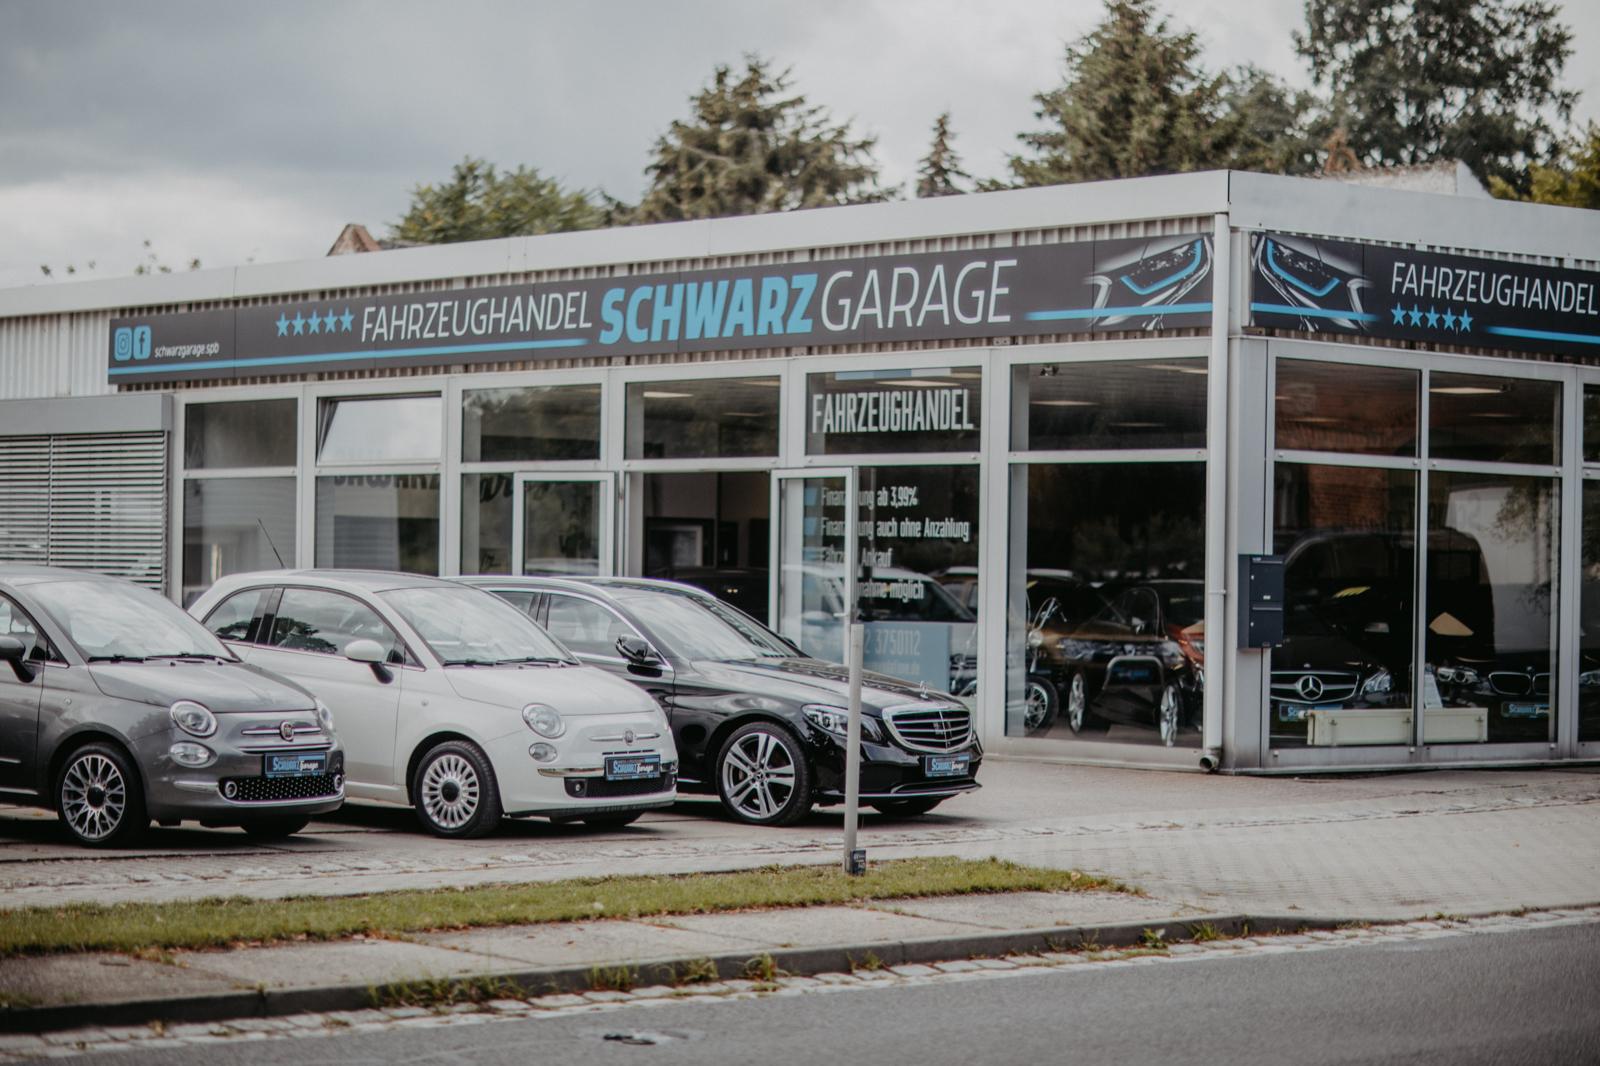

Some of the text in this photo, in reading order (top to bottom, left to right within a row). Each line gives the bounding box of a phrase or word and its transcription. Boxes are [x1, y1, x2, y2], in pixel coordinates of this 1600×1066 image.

[361, 259, 1018, 345] FAHRZEUGHANDEL SCHWARZ GARAGE
[1391, 262, 1598, 315] FAHRZEUGHANDEL
[812, 389, 974, 433] FAHRZEUGHANDEL
[877, 487, 889, 506] ab
[890, 486, 918, 509] 3,99%
[877, 517, 898, 537] auch
[900, 517, 922, 537] ohne
[923, 517, 969, 542] Anzahlung
[889, 578, 924, 603] möglich
